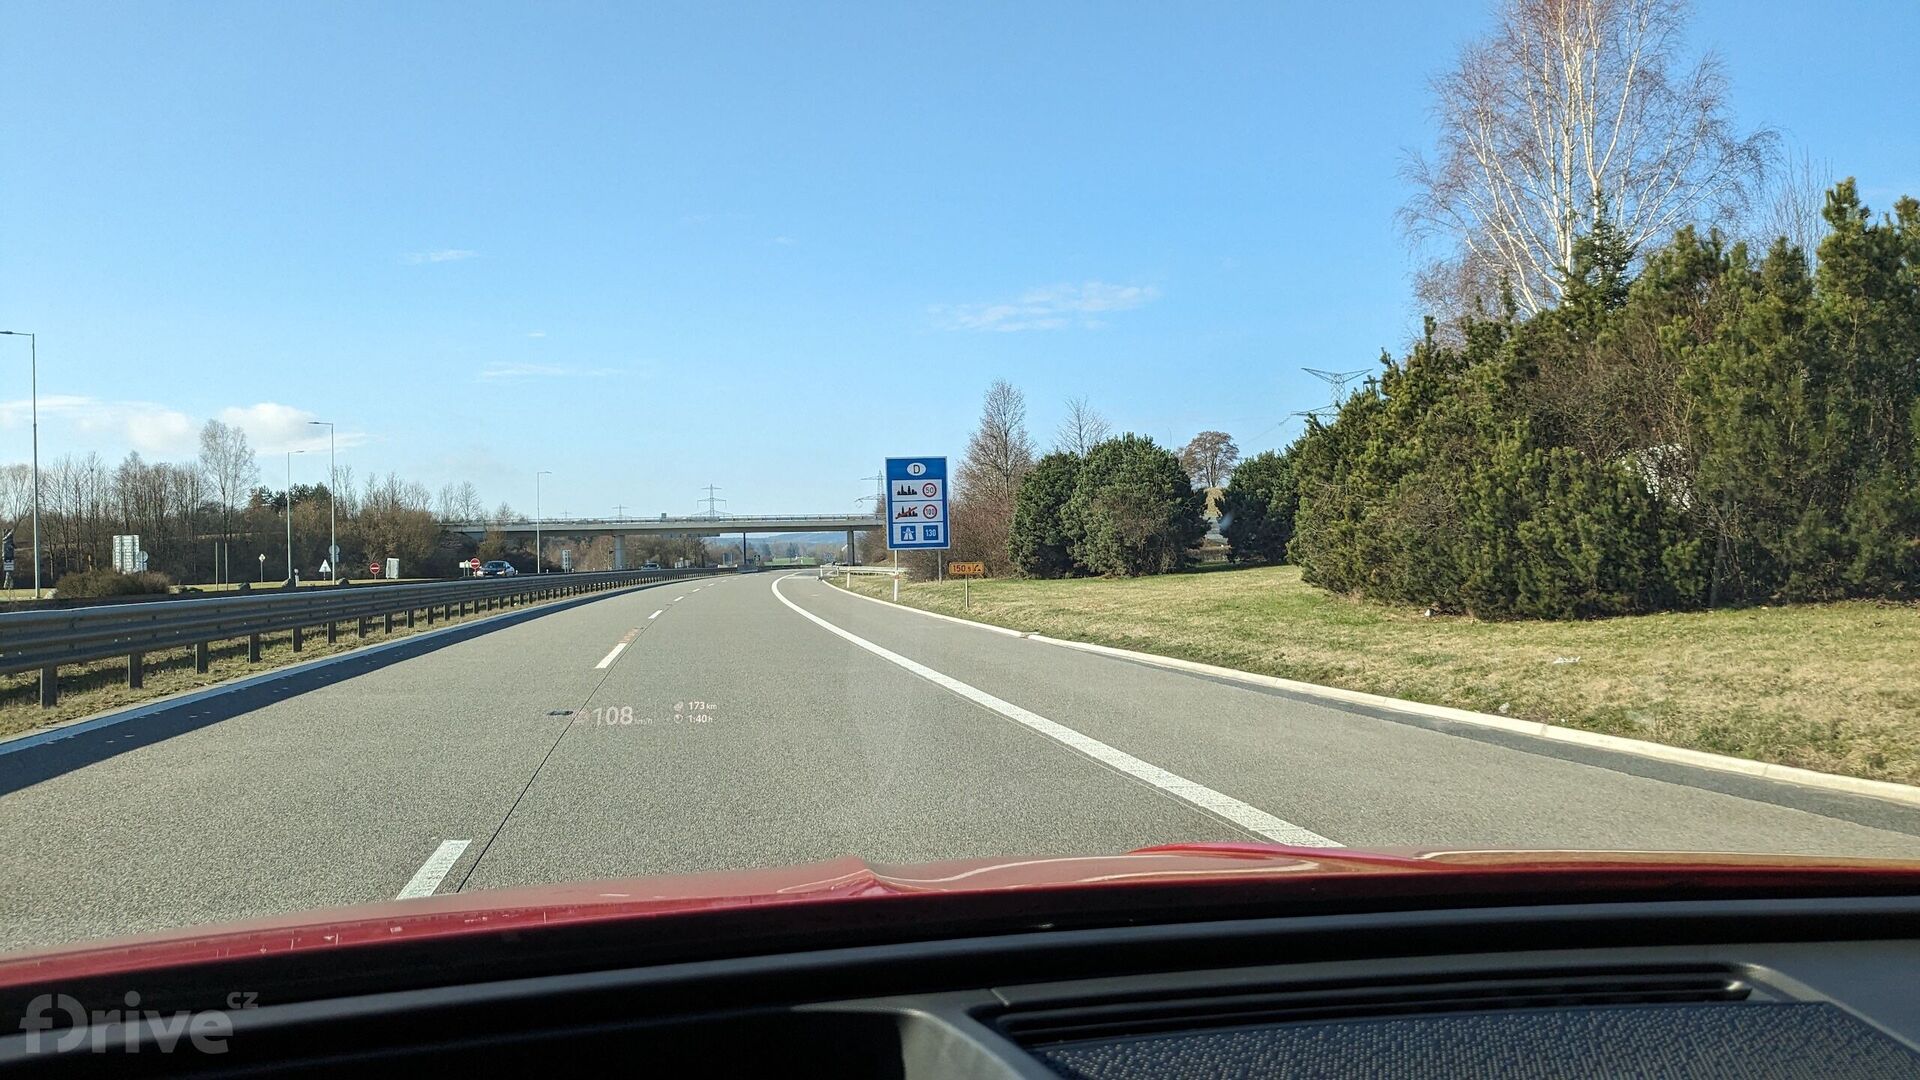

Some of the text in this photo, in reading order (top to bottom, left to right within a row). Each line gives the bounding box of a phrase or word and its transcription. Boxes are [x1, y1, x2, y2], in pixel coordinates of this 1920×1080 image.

[913, 464, 921, 474] D
[925, 486, 934, 494] 50
[925, 529, 937, 537] 130
[953, 564, 966, 573] 150
[689, 701, 705, 710] 173
[593, 706, 633, 725] 108
